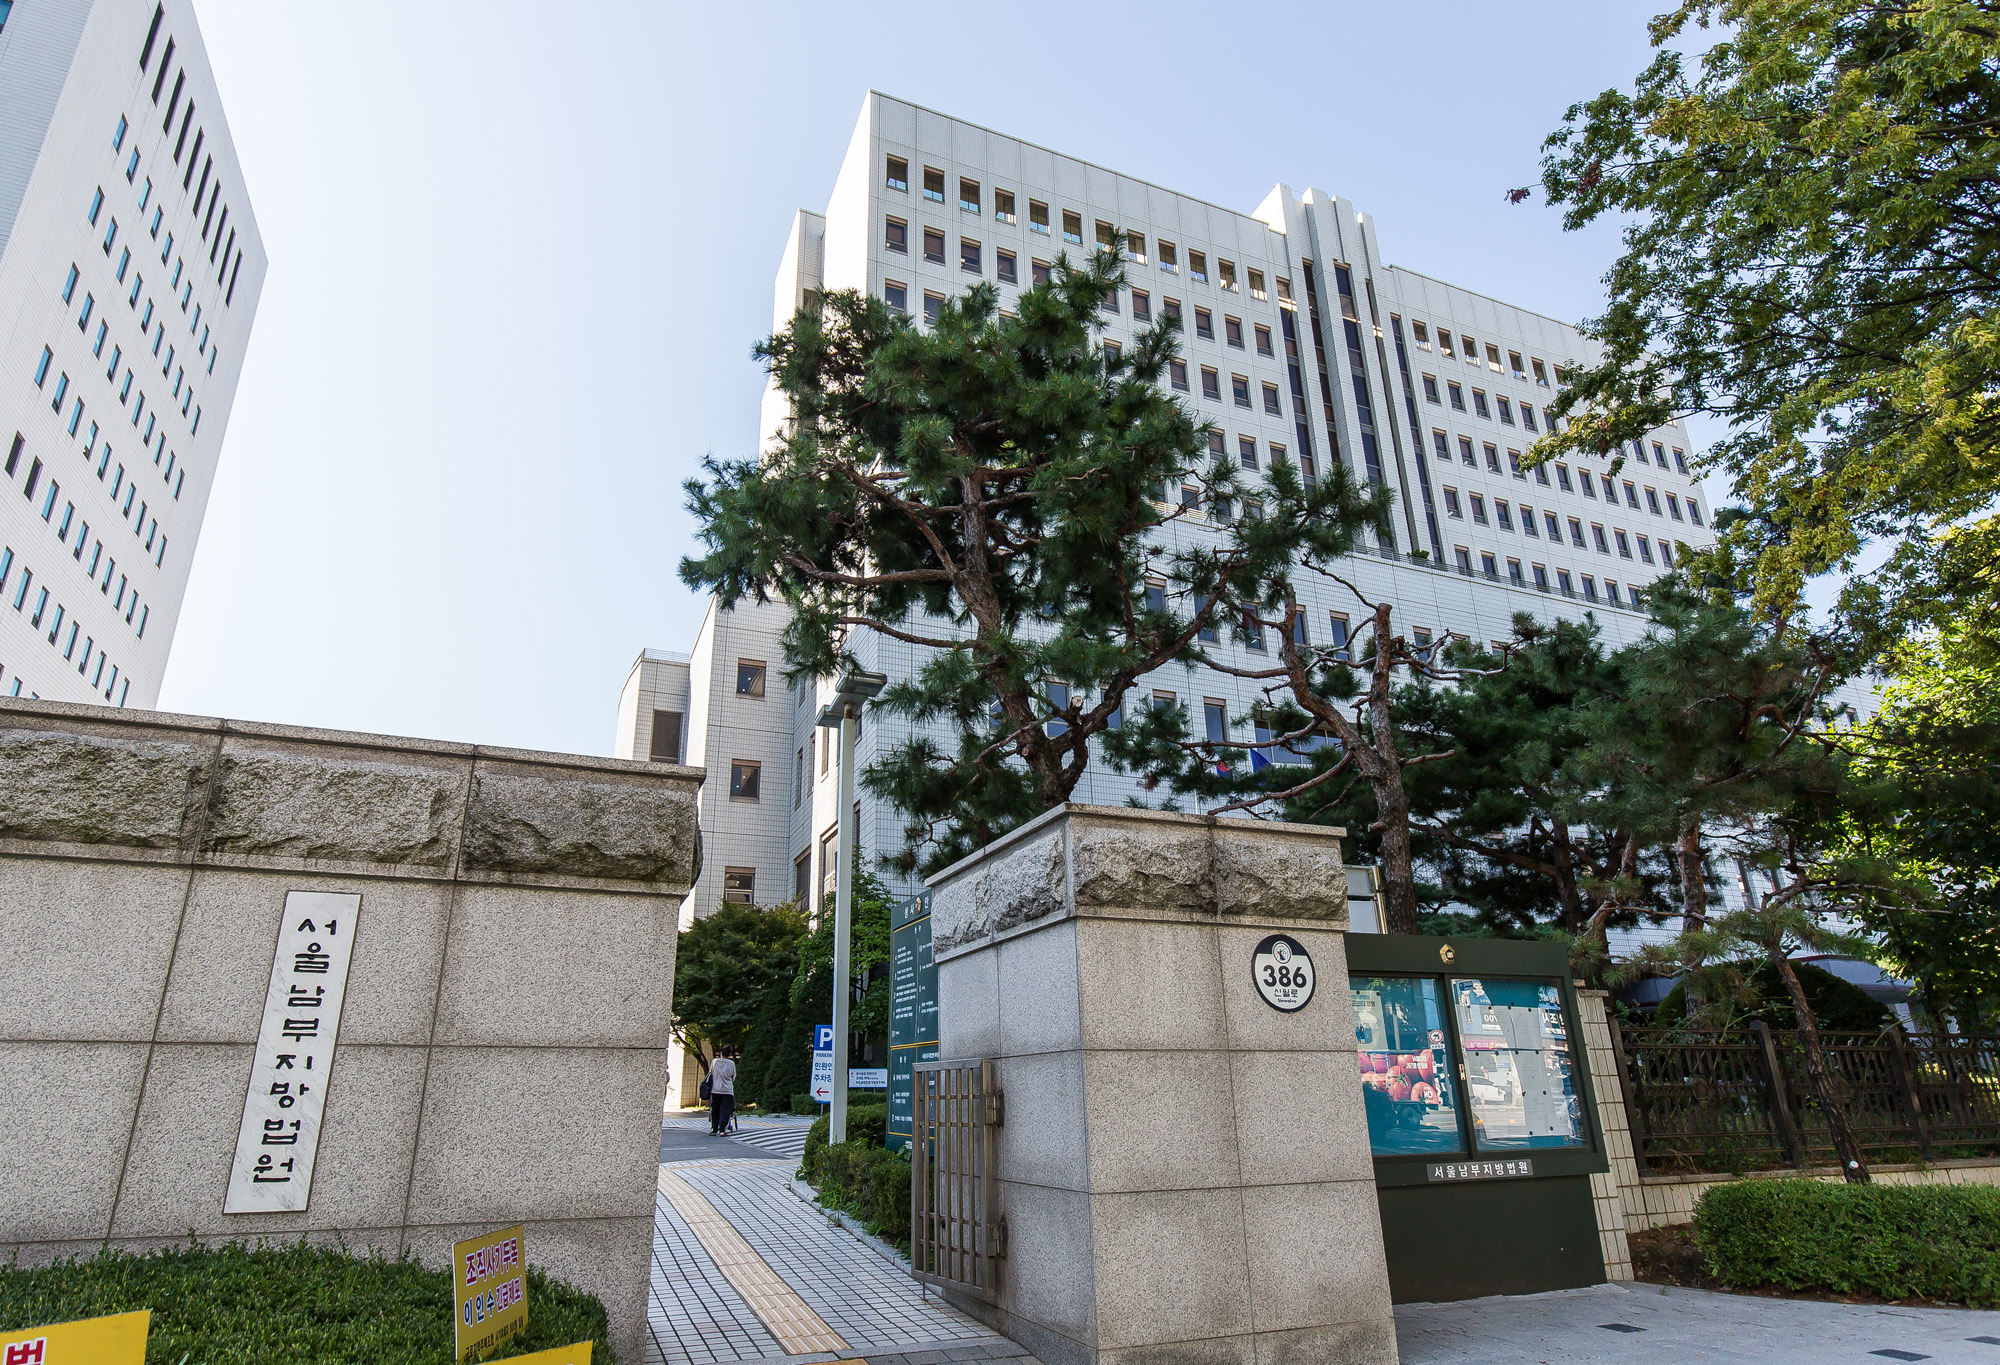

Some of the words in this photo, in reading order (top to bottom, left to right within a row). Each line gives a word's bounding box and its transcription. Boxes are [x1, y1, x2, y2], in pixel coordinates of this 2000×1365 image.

[1263, 964, 1307, 988] 386
[1274, 988, 1298, 998] 신월로
[819, 1028, 833, 1048] P
[252, 918, 338, 1183] 서울남부지방법원
[1434, 1161, 1528, 1178] 서울남부지방법원
[465, 1237, 519, 1287] 조직사기두목
